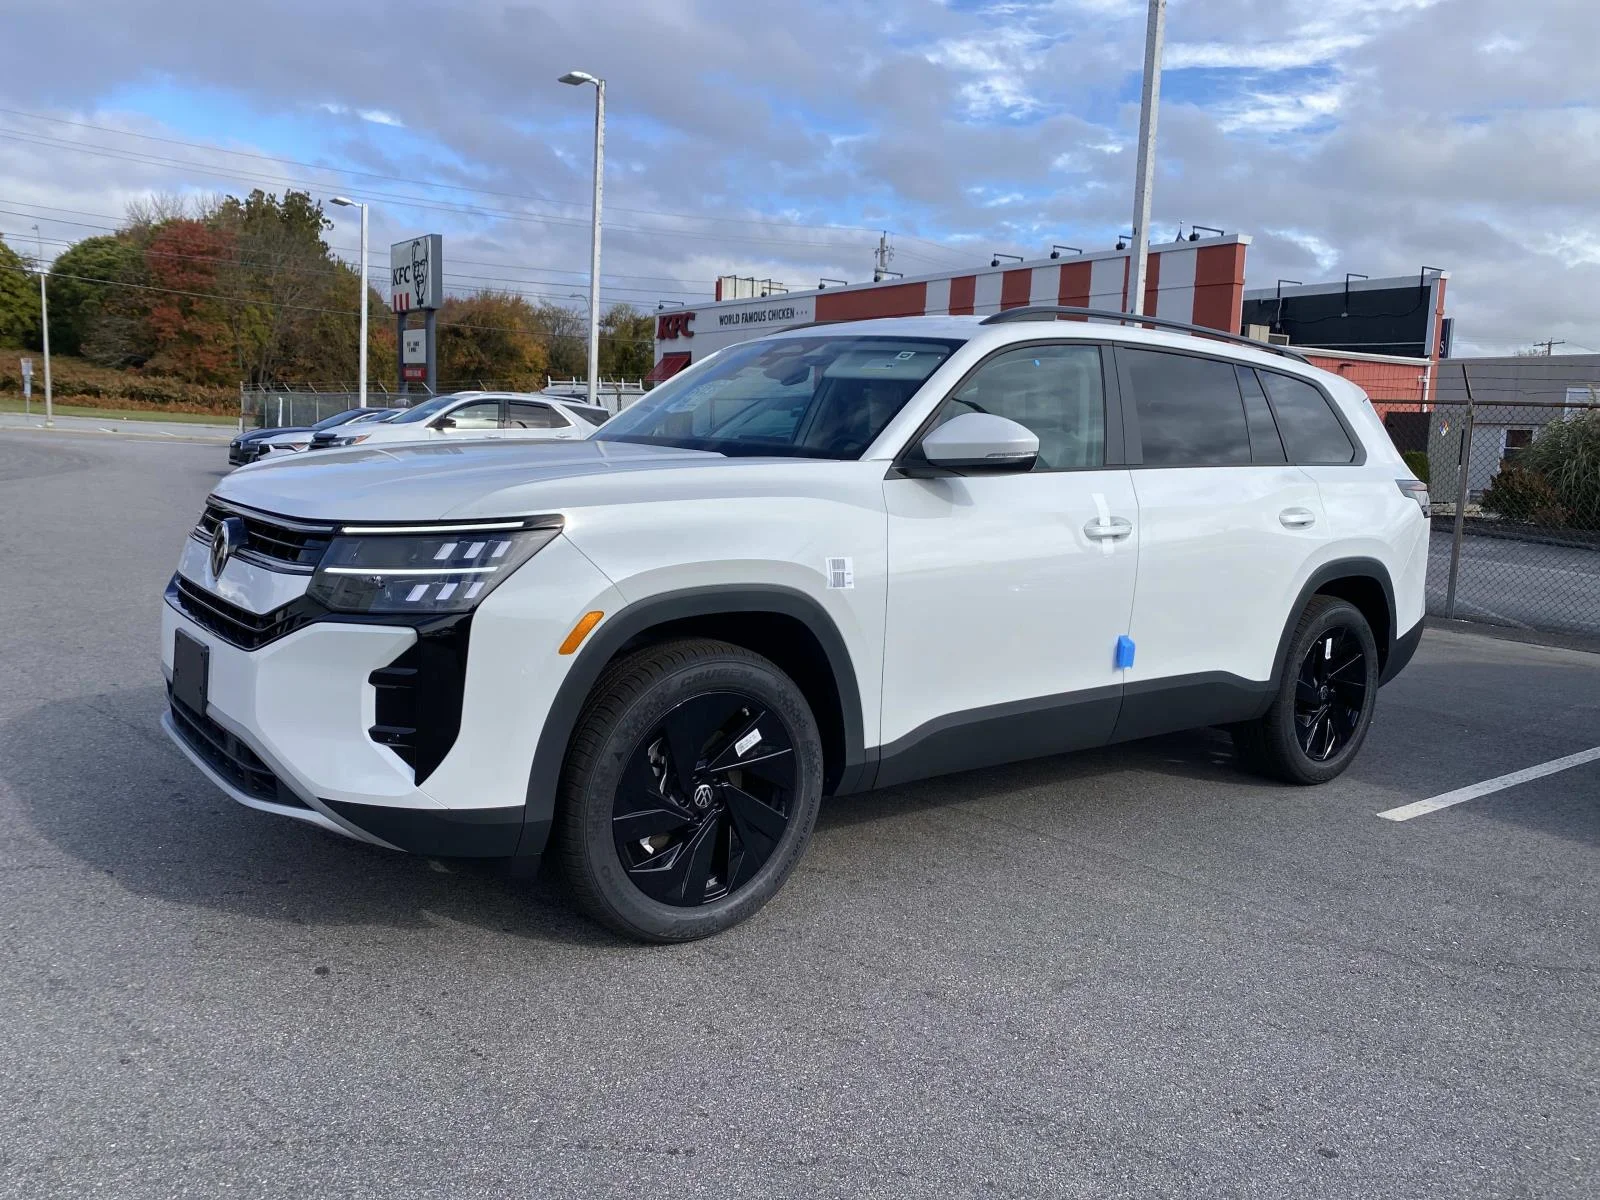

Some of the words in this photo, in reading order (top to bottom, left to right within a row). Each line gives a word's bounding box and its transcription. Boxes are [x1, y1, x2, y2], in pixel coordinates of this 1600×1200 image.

[392, 265, 411, 287] KFC
[656, 311, 696, 340] KFC
[719, 313, 740, 326] WORLD
[741, 310, 766, 324] FAMOUS
[768, 308, 795, 321] CHICKEN
